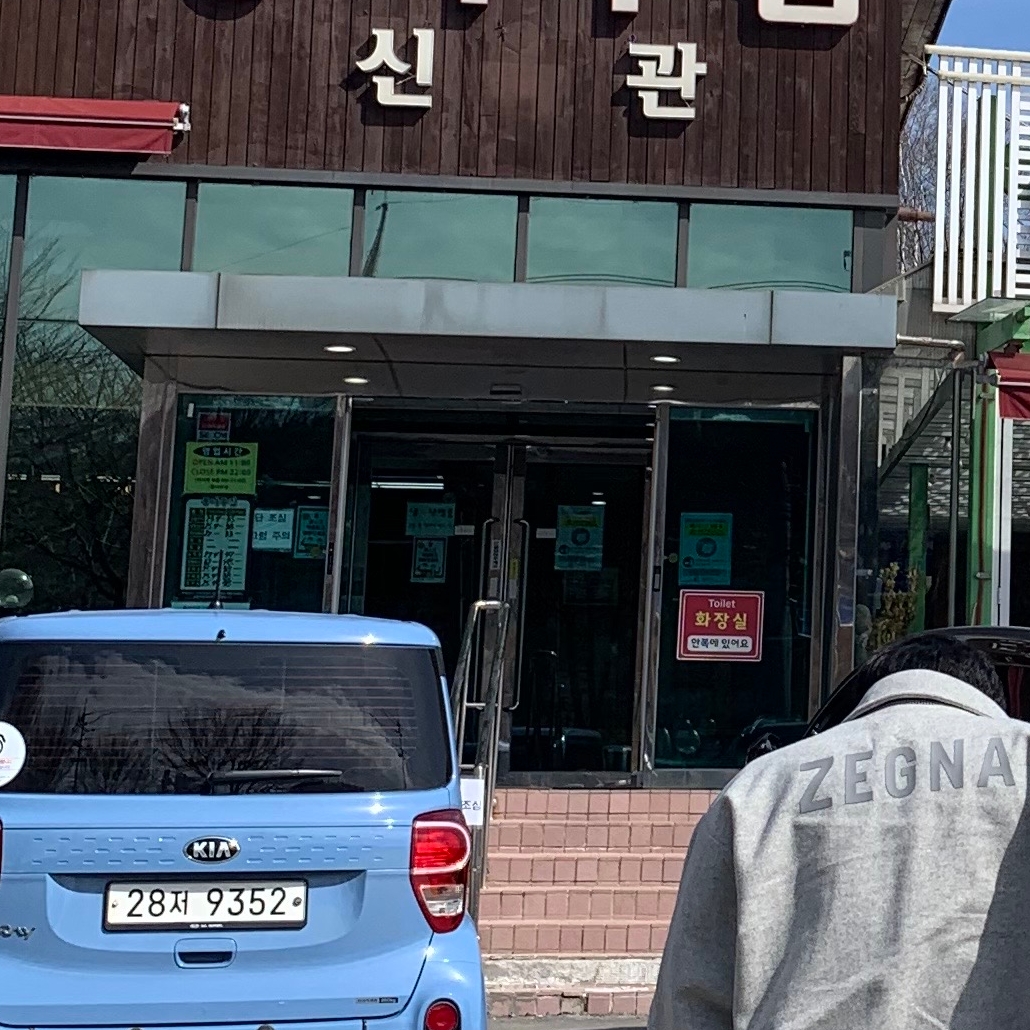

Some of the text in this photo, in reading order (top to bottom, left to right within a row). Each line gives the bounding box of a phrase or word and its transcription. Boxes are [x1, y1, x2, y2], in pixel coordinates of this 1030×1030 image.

[268, 513, 287, 523] 조심
[272, 531, 291, 541] 주의
[708, 599, 736, 609] Toilet
[694, 611, 748, 630] 화장실
[721, 638, 749, 649] 있어요
[799, 737, 1016, 814] ZEGNA
[462, 800, 481, 811] 조심
[192, 841, 231, 858] KIA
[127, 887, 287, 917] 28저 9352
